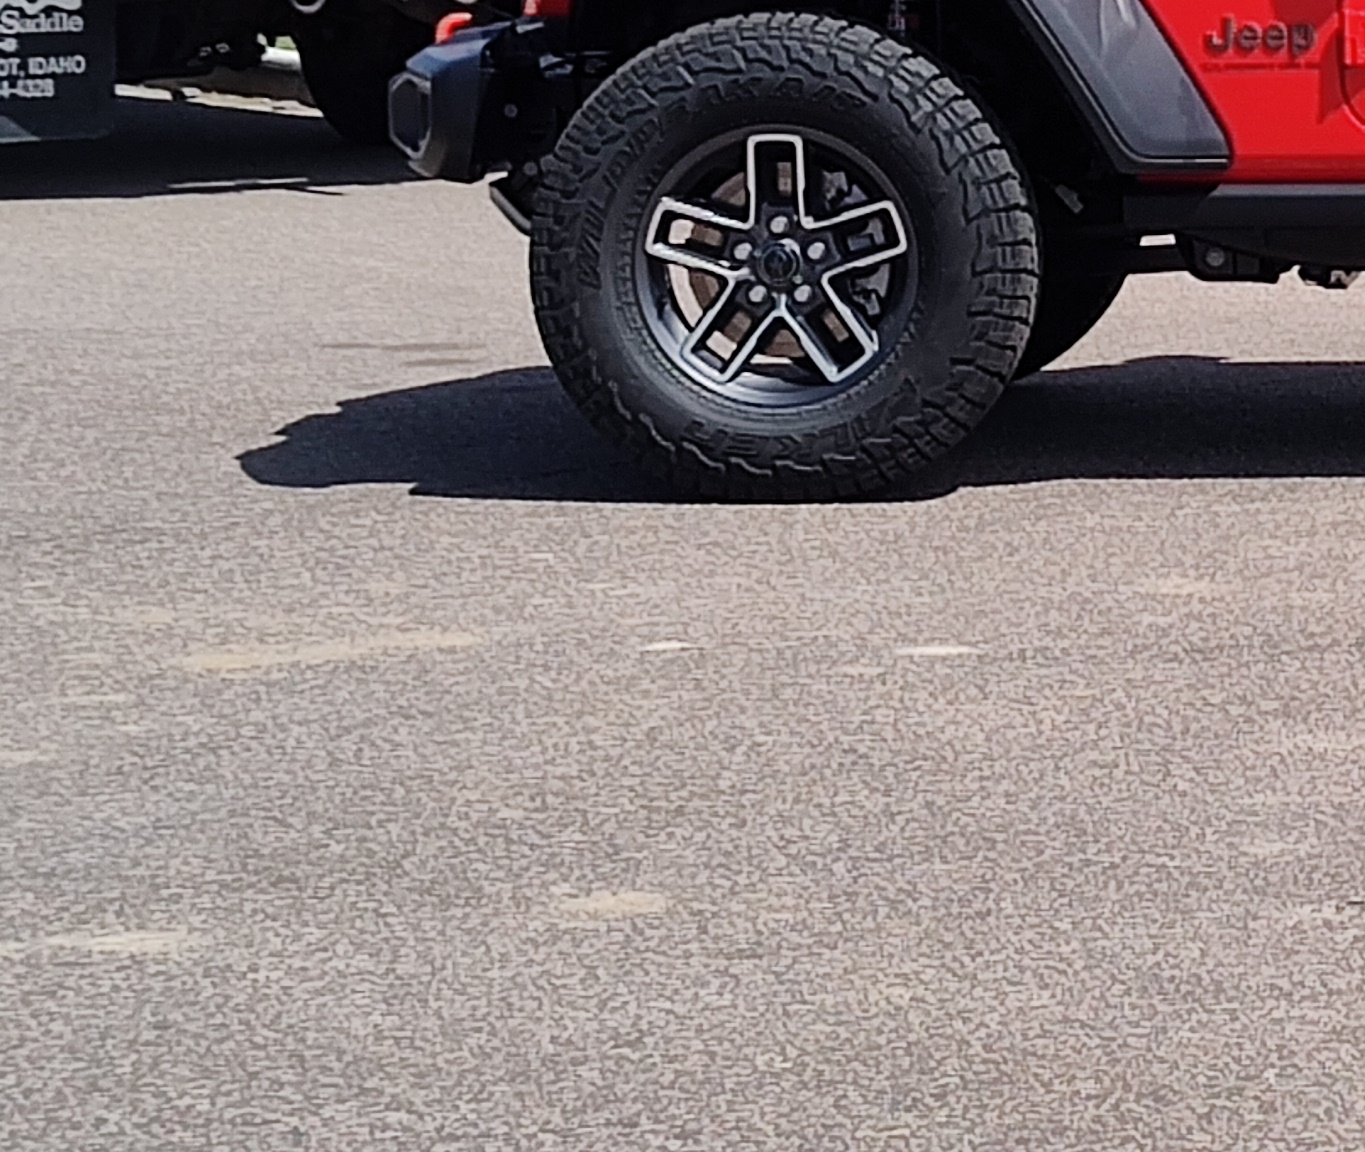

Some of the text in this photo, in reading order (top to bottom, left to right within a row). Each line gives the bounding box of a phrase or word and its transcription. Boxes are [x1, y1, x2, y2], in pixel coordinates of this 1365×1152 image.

[0, 10, 84, 35] Saddle
[1204, 14, 1318, 58] Jeep
[28, 54, 86, 75] IDAHO
